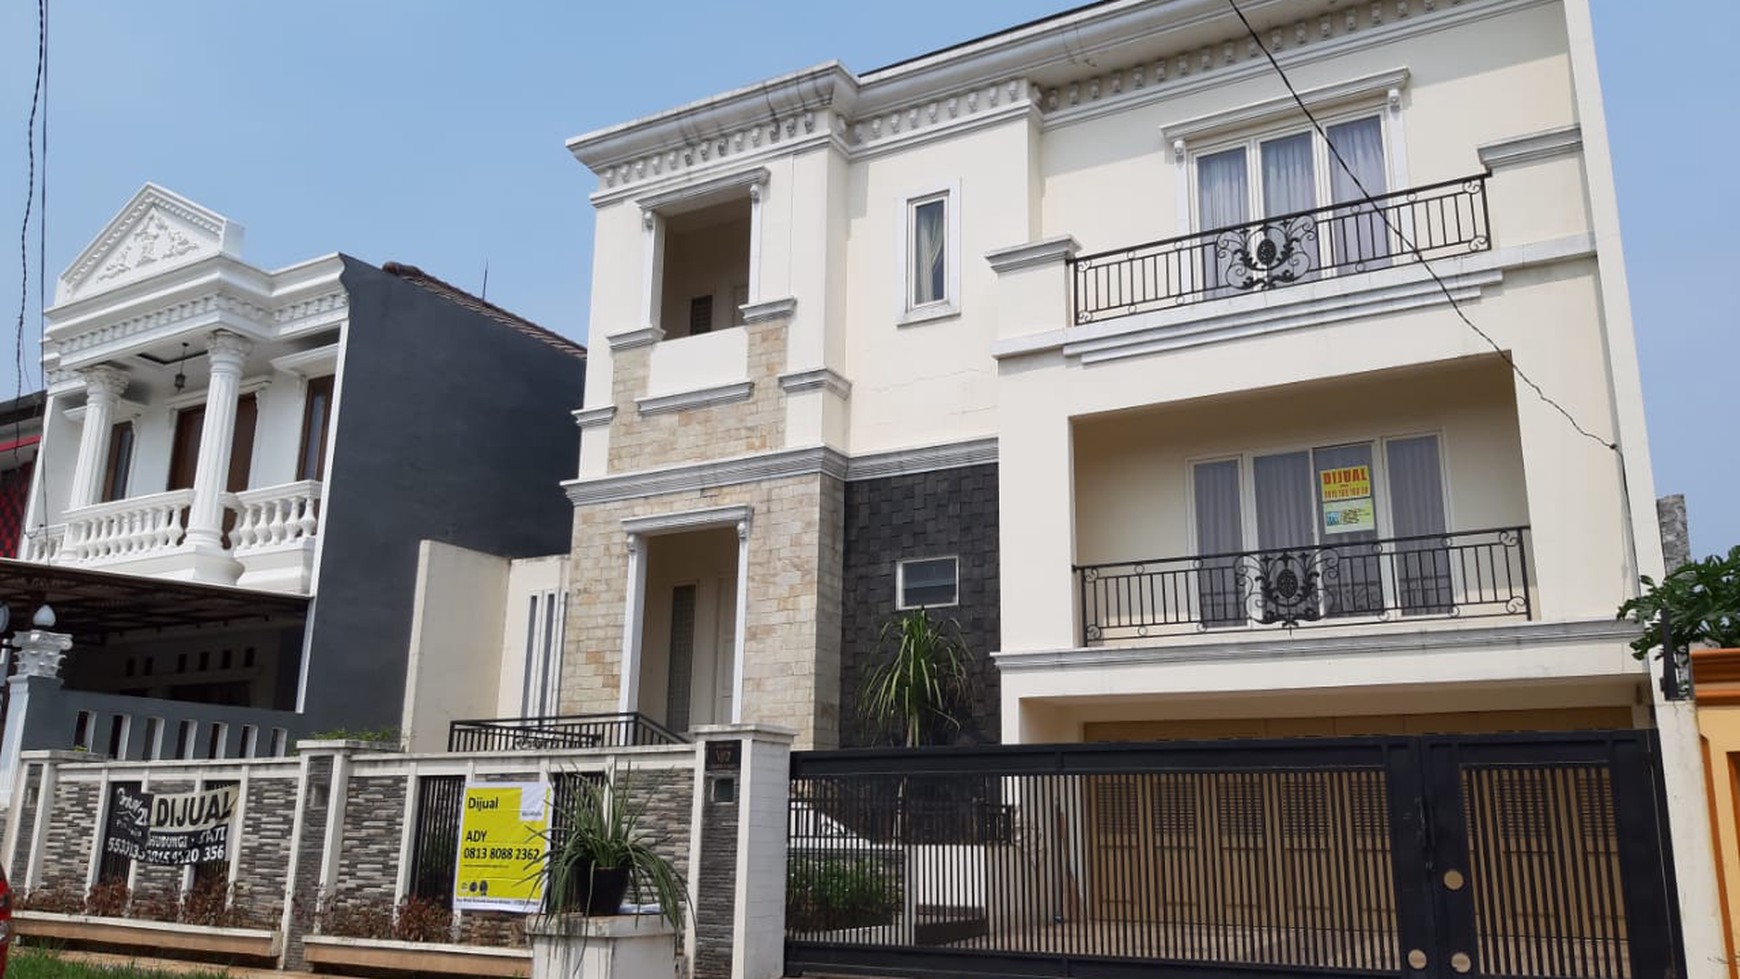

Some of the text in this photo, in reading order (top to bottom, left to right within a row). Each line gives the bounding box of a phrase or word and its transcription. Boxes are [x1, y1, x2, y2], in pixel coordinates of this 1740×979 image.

[1323, 468, 1367, 484] DIJUAL
[156, 791, 232, 828] DIJUAL
[468, 797, 499, 811] Dijual
[466, 830, 487, 842] ADY
[202, 844, 224, 861] 356
[464, 847, 540, 861] 0813 8088 2362
